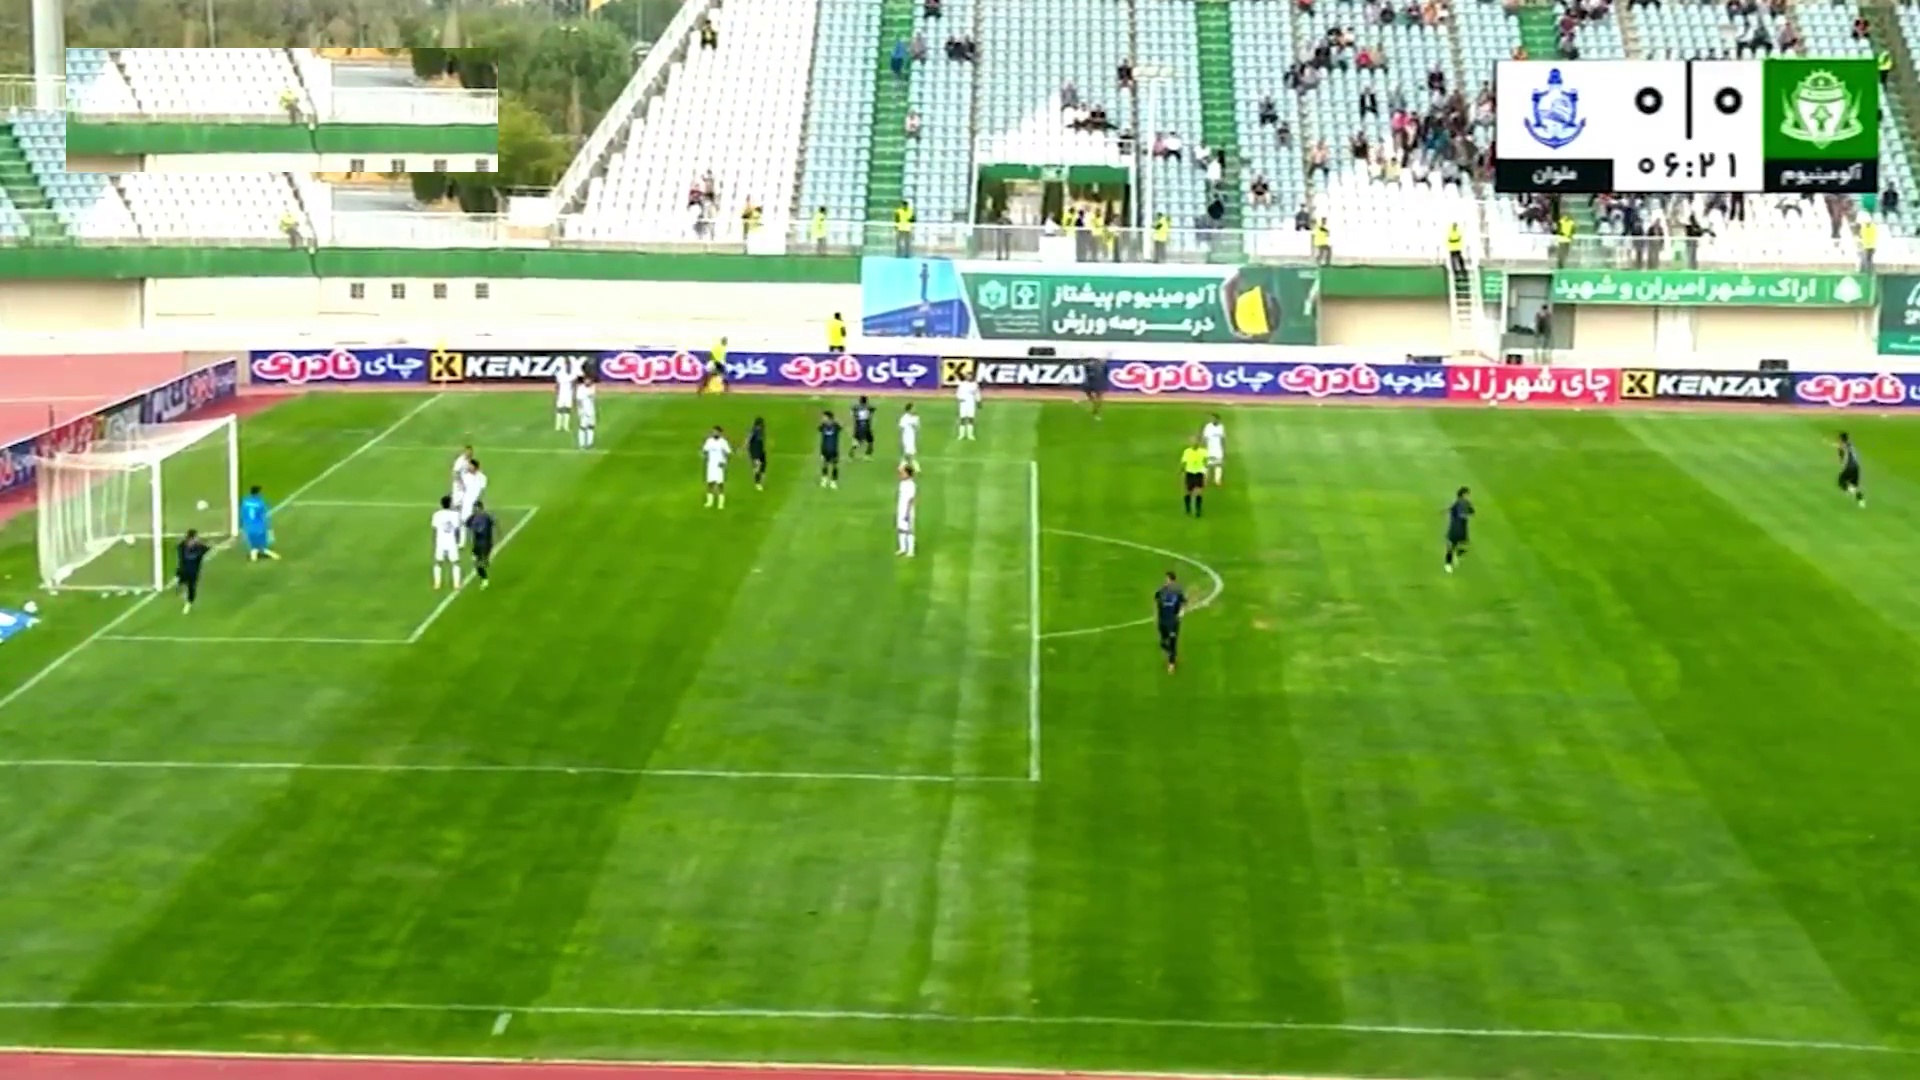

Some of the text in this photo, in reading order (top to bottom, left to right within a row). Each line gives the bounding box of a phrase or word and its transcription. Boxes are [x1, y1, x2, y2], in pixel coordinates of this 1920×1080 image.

[1051, 282, 1217, 311] آلومینیوم پیشتاز
[1619, 282, 1633, 300] و
[1635, 276, 1705, 301] امیران
[1706, 275, 1756, 301] شهر
[1052, 310, 1108, 335] ورزش
[252, 348, 362, 384] نادری
[365, 353, 423, 378] چای
[465, 356, 586, 377] KENZAX
[601, 350, 703, 384] نادری
[779, 354, 928, 386] چای نادری
[1108, 361, 1274, 393] چای نادری
[1278, 364, 1445, 397] کلوچه نادری
[1452, 367, 1610, 402] چای شهرزاد
[1656, 375, 1782, 398] KENZAX
[1796, 373, 1905, 406] نادری
